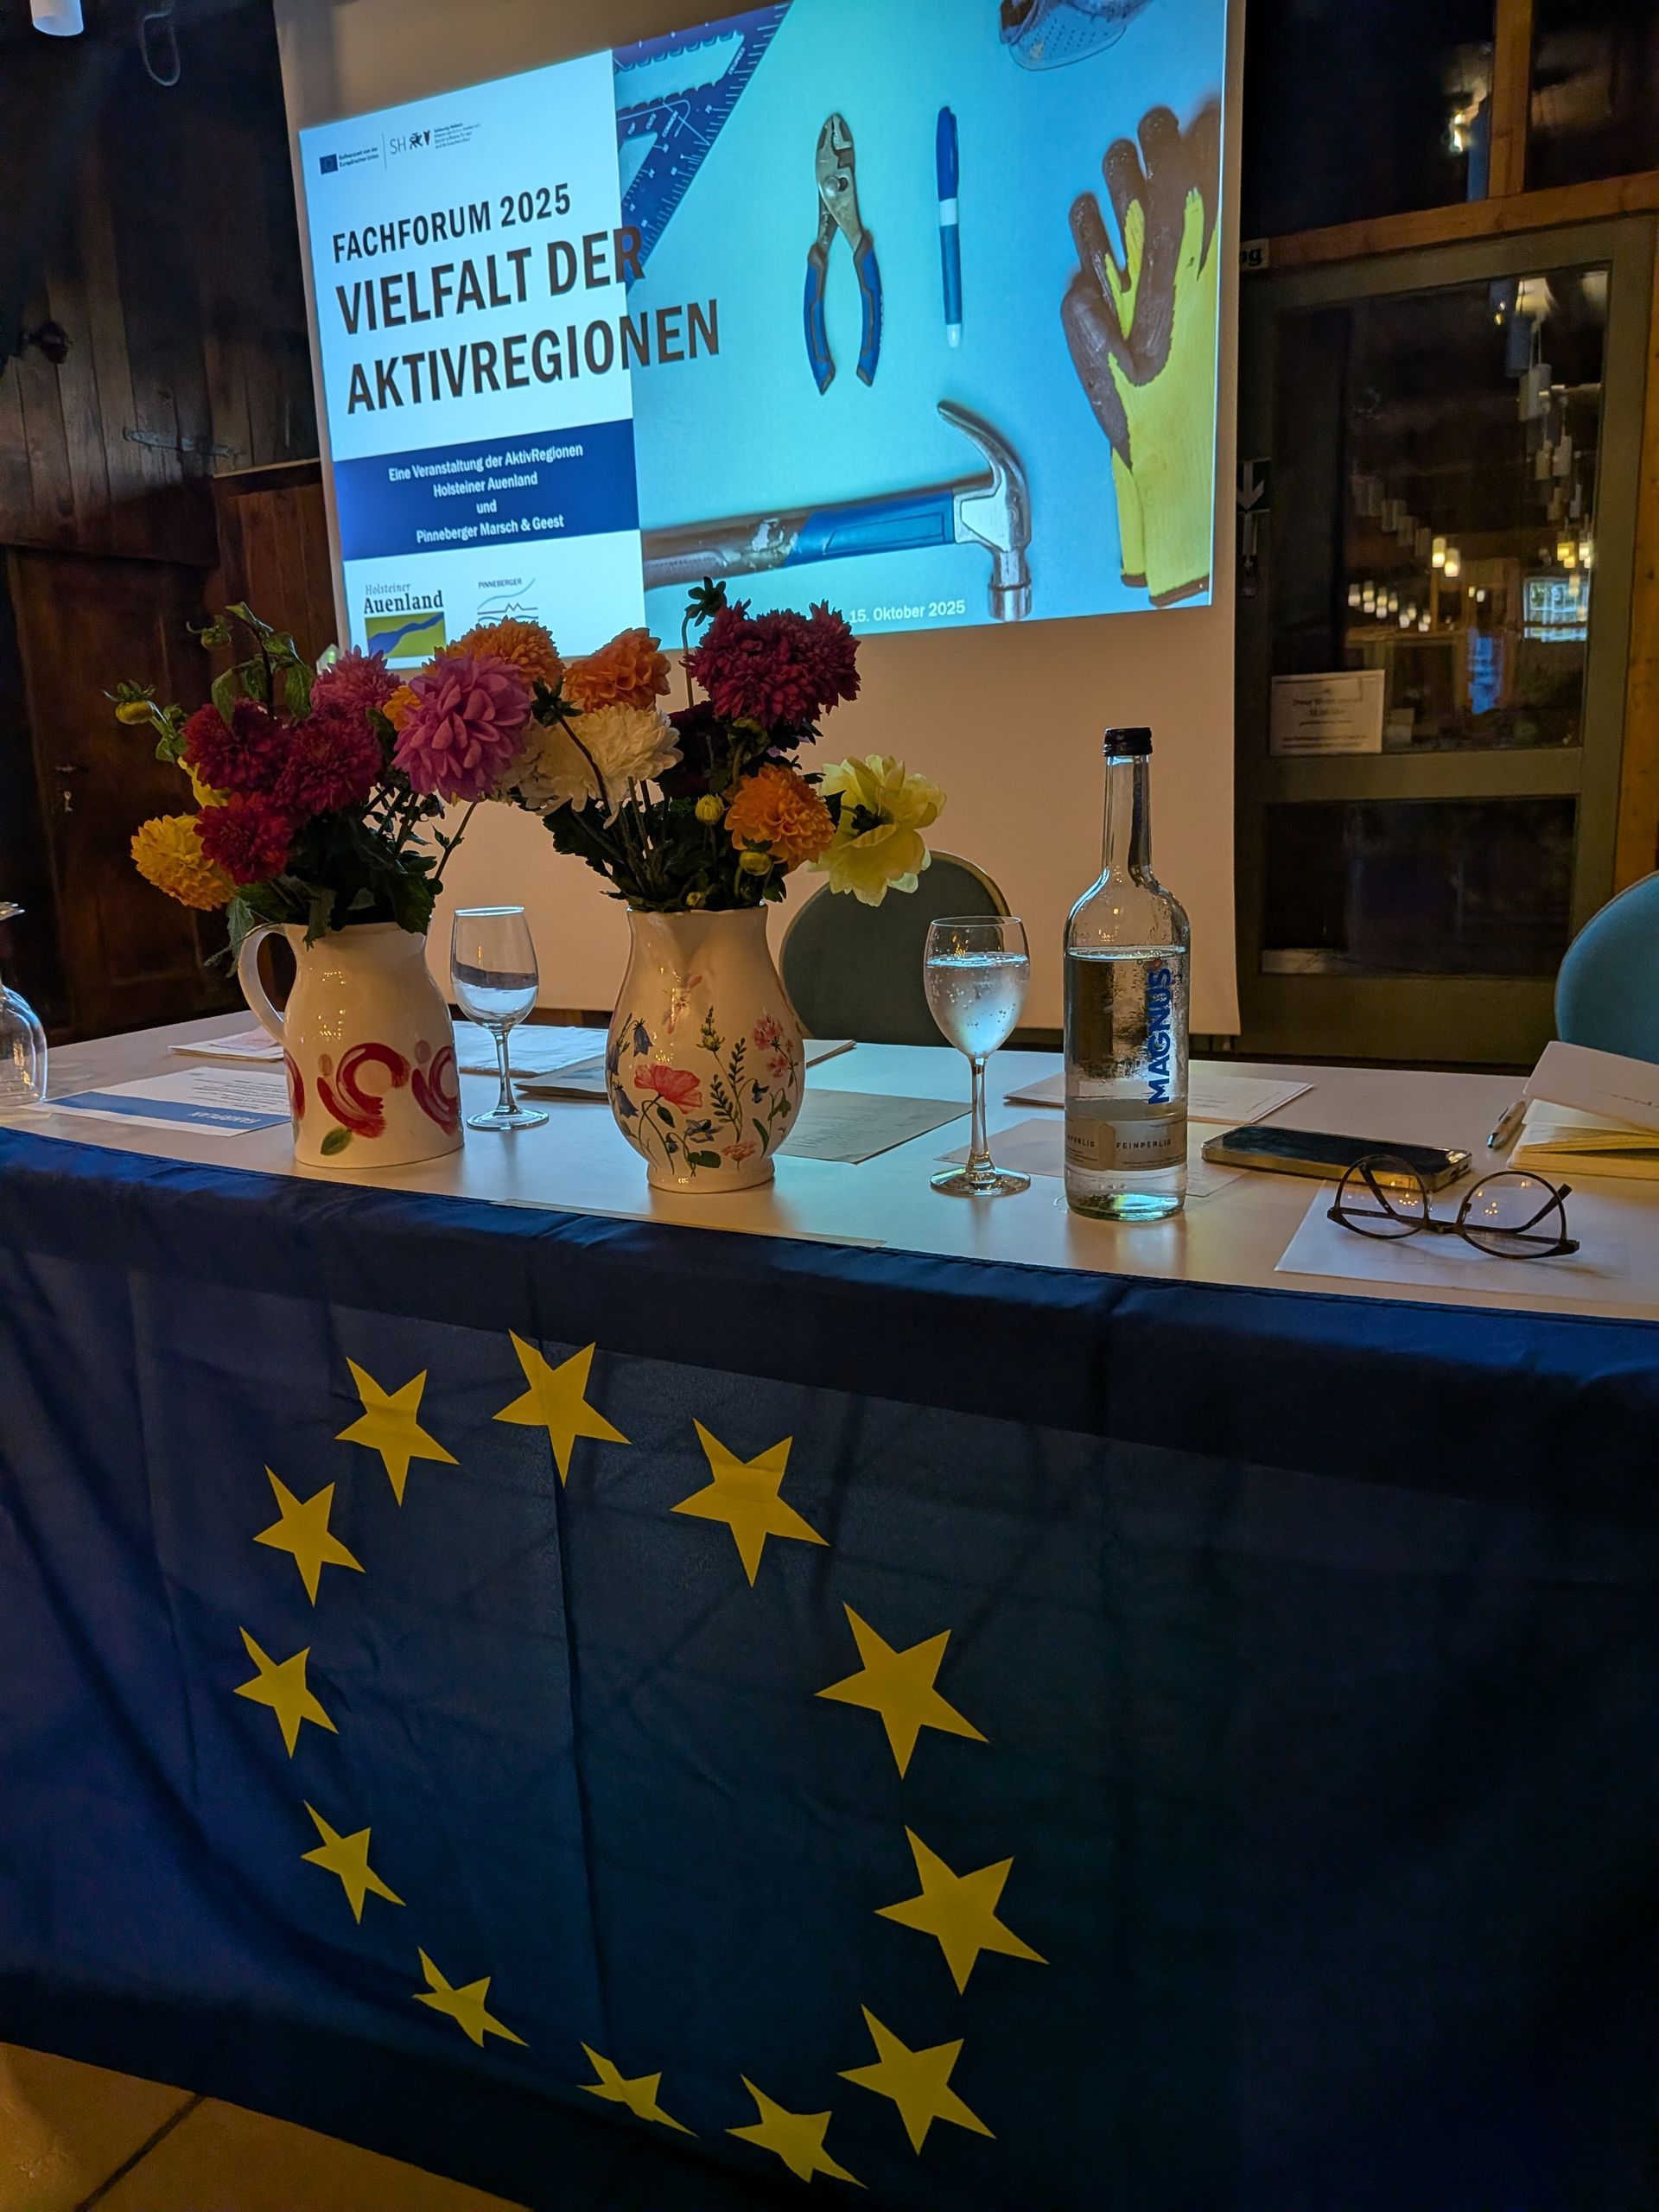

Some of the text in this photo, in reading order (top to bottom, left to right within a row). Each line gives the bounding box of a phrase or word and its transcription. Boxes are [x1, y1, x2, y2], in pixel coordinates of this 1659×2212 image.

[389, 136, 407, 155] SH
[333, 183, 571, 263] FACHFORUM 2025
[336, 226, 646, 335] VIELFALT DER
[347, 299, 720, 415] AKTIVREGIONEN
[389, 444, 583, 482] Eine Veranstaltung der AktivRegionen
[433, 471, 538, 499] Holsteiner Auenland
[476, 499, 498, 514] und
[416, 514, 564, 544] Pinneberger Marsch & Geest
[365, 583, 410, 596] Holsteiner
[478, 577, 522, 588] PINNEBERGER
[364, 589, 444, 614] Auenland
[849, 599, 965, 623] 15. Oktober 2025
[1147, 968, 1171, 1105] MAGNUS
[1116, 1138, 1172, 1149] FEINPERLIG
